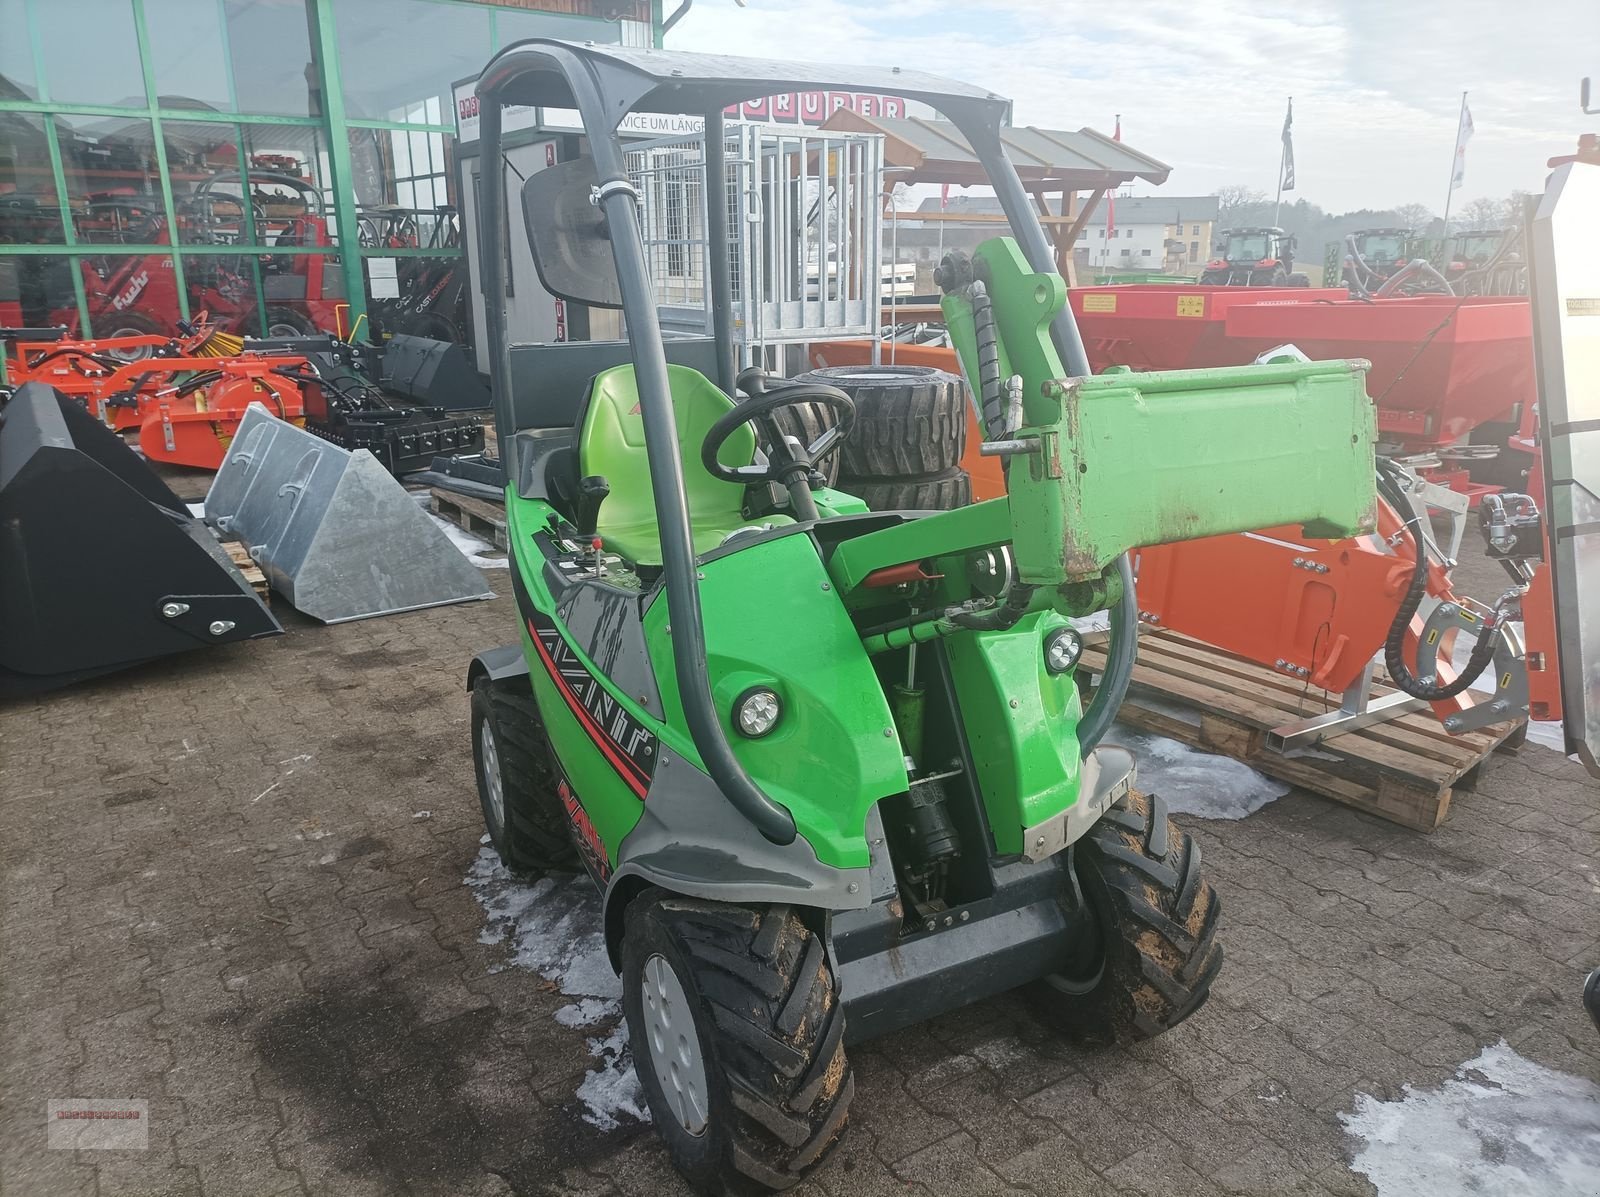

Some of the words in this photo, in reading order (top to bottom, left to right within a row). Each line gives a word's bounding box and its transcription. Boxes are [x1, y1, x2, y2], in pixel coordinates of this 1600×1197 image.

[621, 116, 647, 129] VICE
[650, 118, 669, 130] UM
[536, 629, 655, 757] AVANT
